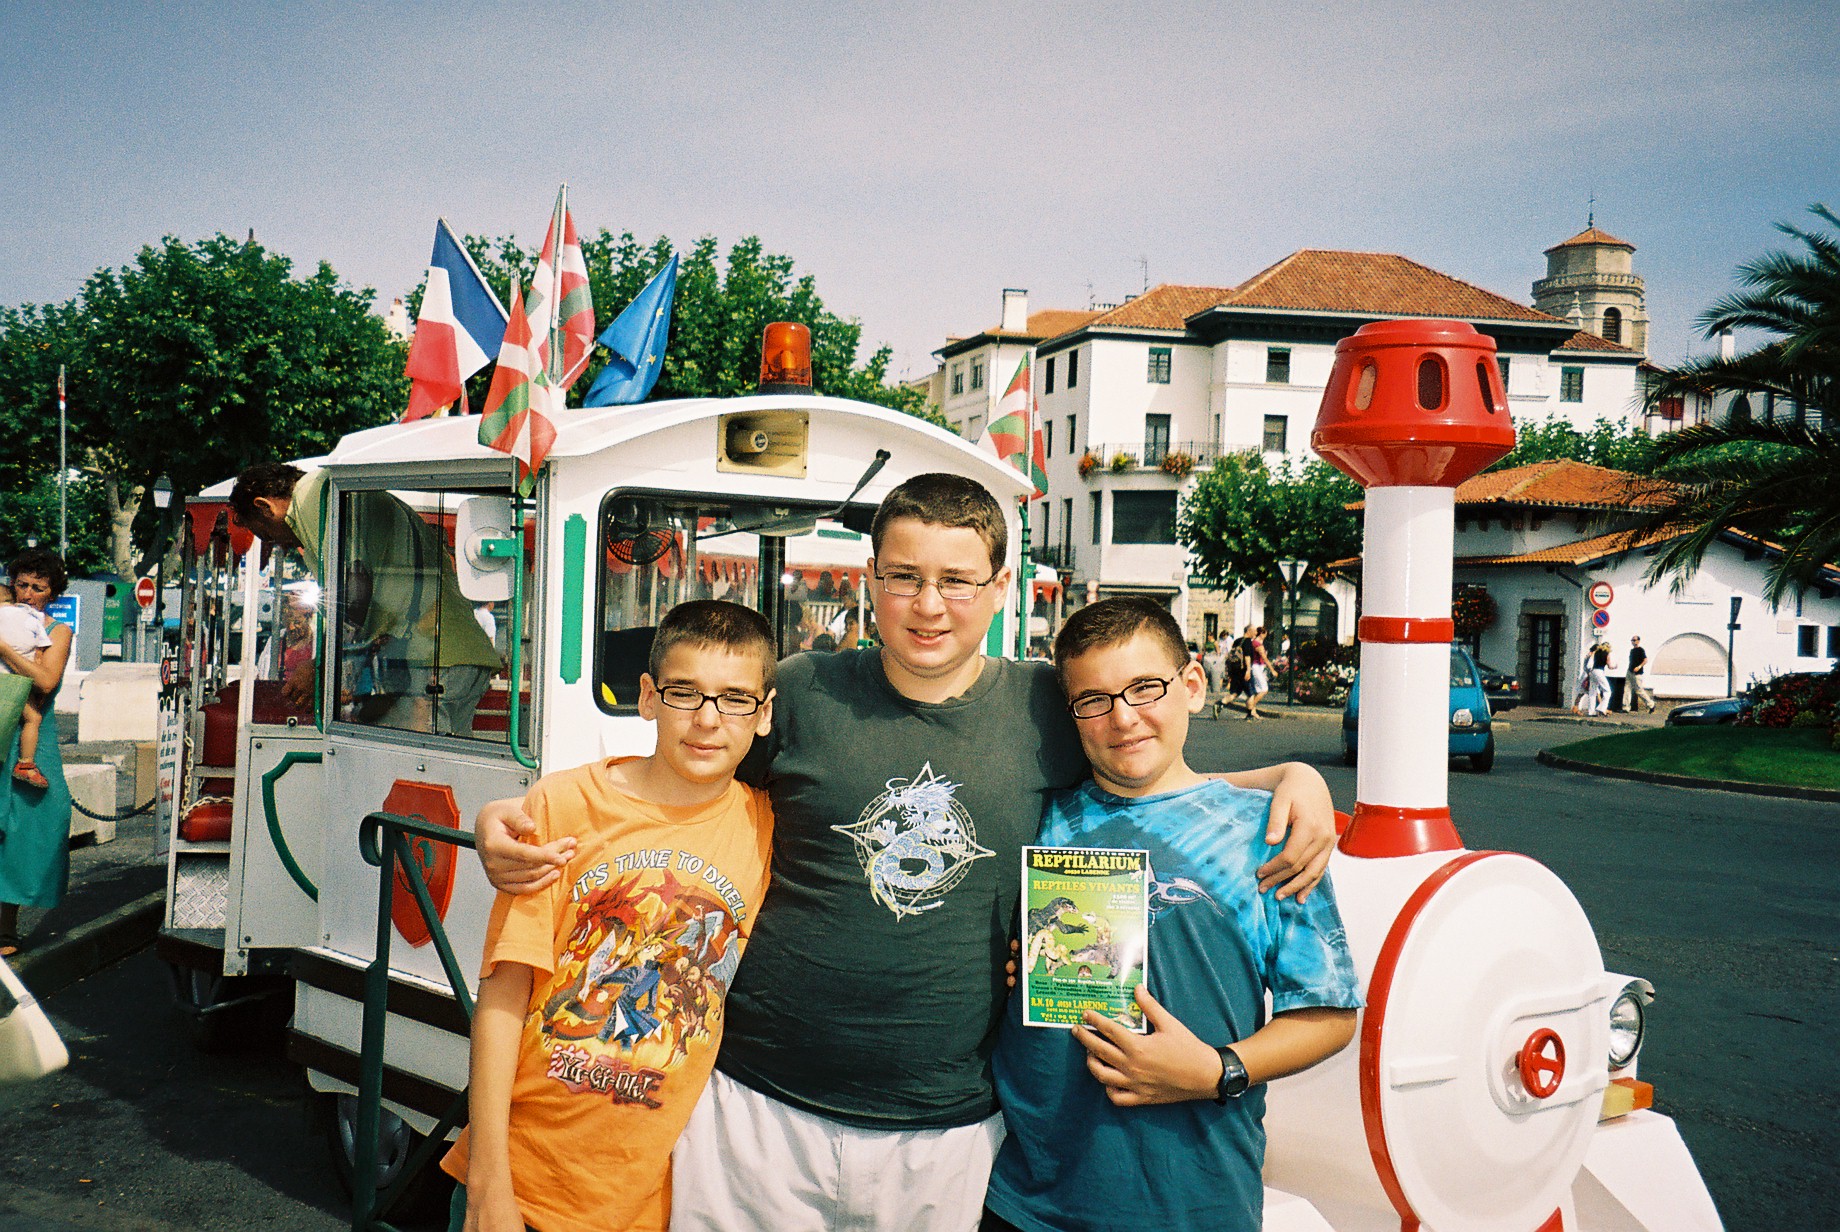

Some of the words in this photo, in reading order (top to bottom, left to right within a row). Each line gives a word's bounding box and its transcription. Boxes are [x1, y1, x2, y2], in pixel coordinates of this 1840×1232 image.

[1032, 854, 1140, 870] REPTILARIUM
[572, 863, 609, 902] IT'S
[614, 849, 672, 873] TIME
[676, 850, 704, 874] TO
[702, 864, 746, 926] DUEL!
[1033, 880, 1087, 892] REPTILES
[1088, 882, 1140, 894] VIVANTS
